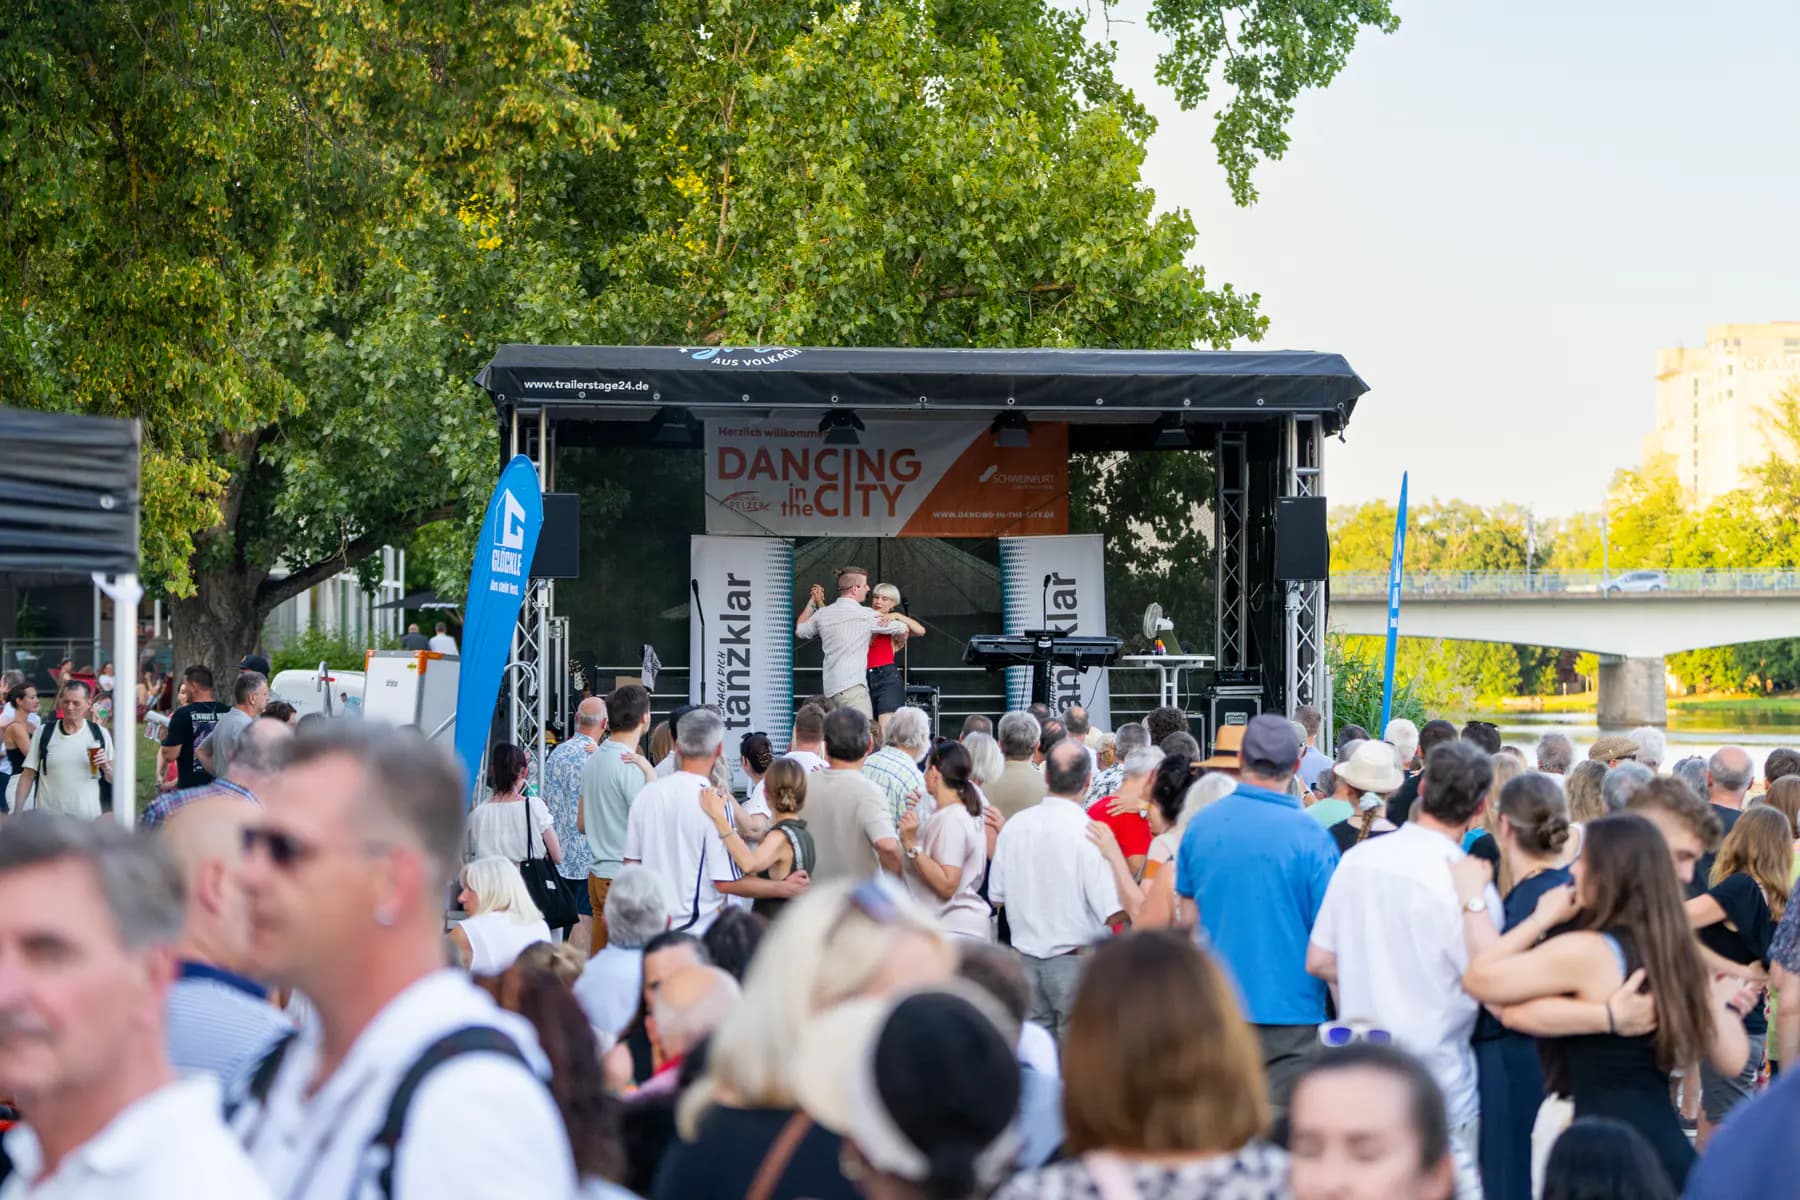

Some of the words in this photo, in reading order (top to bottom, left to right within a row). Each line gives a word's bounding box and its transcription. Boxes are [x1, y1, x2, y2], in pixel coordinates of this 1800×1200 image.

[711, 357, 739, 366] AUS
[742, 347, 802, 366] VOLKACH
[523, 380, 649, 392] www.trailerstage24.de
[718, 426, 762, 437] Herzlich
[718, 446, 922, 483] DANCING
[781, 500, 813, 517] the
[814, 483, 905, 518] CITY
[789, 483, 807, 501] in
[492, 548, 522, 577] GLÖCKLE
[716, 651, 726, 676] DICH
[719, 572, 752, 731] tanzklar
